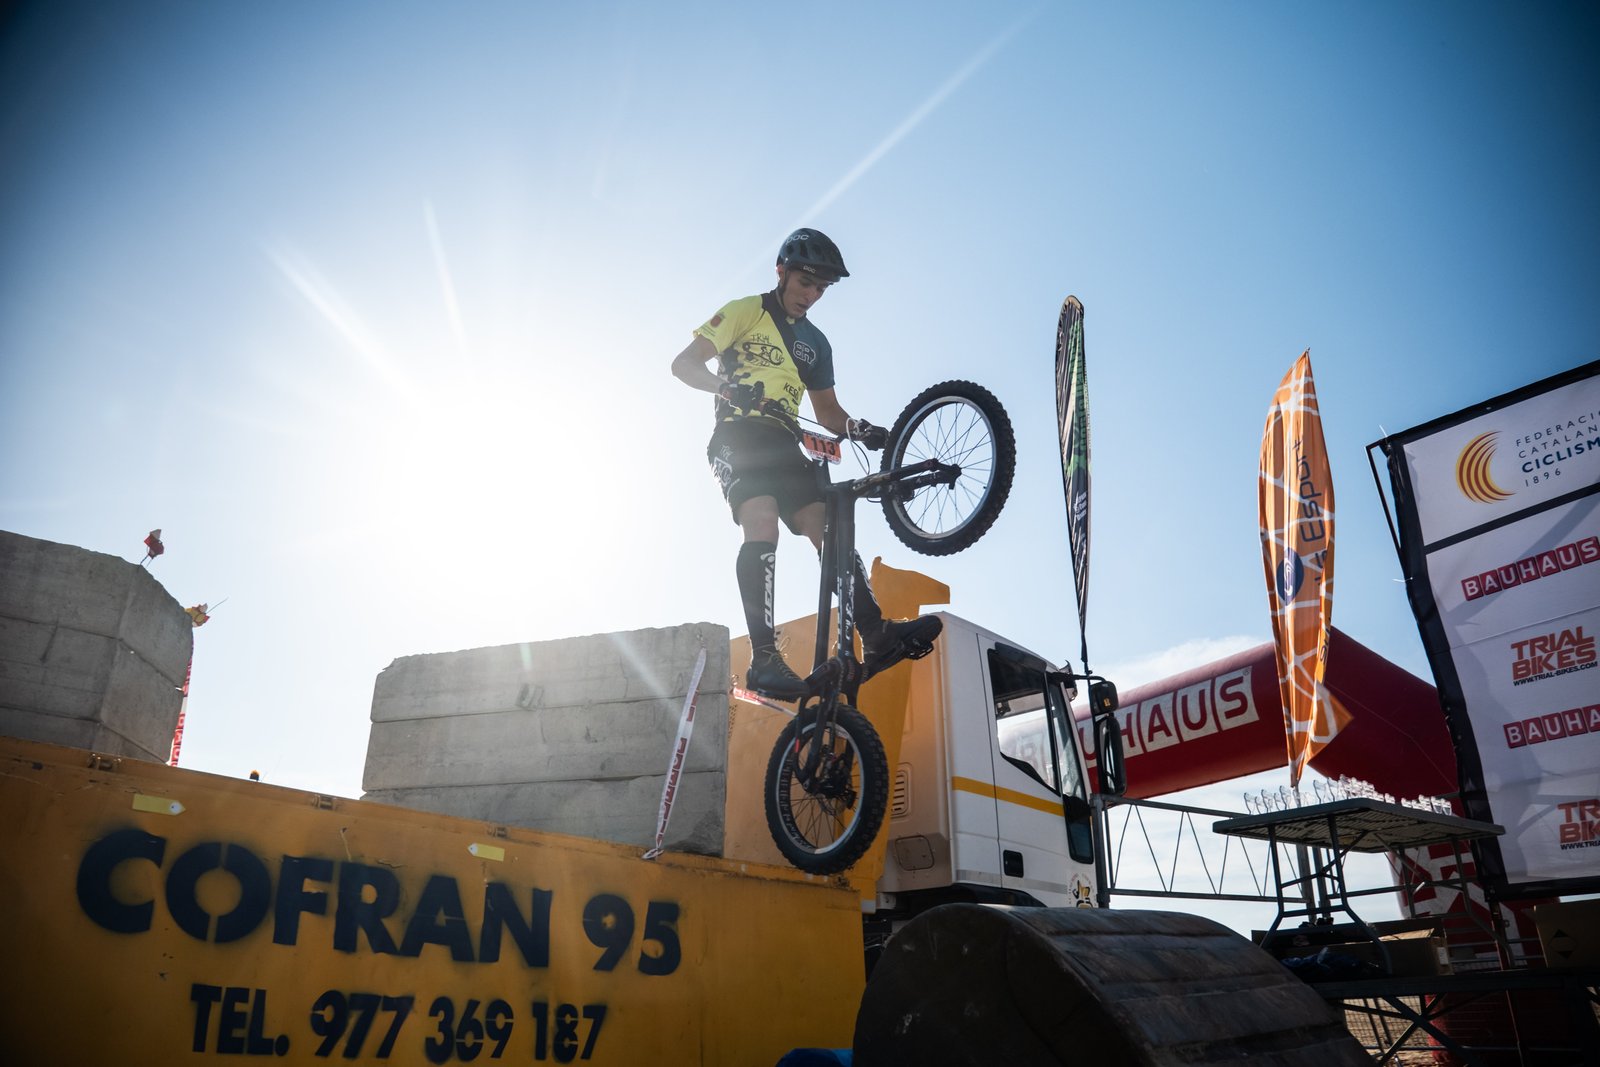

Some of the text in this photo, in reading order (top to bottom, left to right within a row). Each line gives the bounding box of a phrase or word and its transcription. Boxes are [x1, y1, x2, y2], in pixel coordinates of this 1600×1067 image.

[811, 436, 836, 456] 113
[1525, 468, 1561, 487] 1896
[1464, 540, 1599, 598] BAUHAUS
[1511, 626, 1594, 660] TRIAL
[1512, 643, 1597, 680] BIKES
[1513, 661, 1598, 686] WWW.TRIAL-BIKES.COM
[77, 829, 682, 977] COFRAN 95
[190, 983, 608, 1064] TEL. 977 369 187
